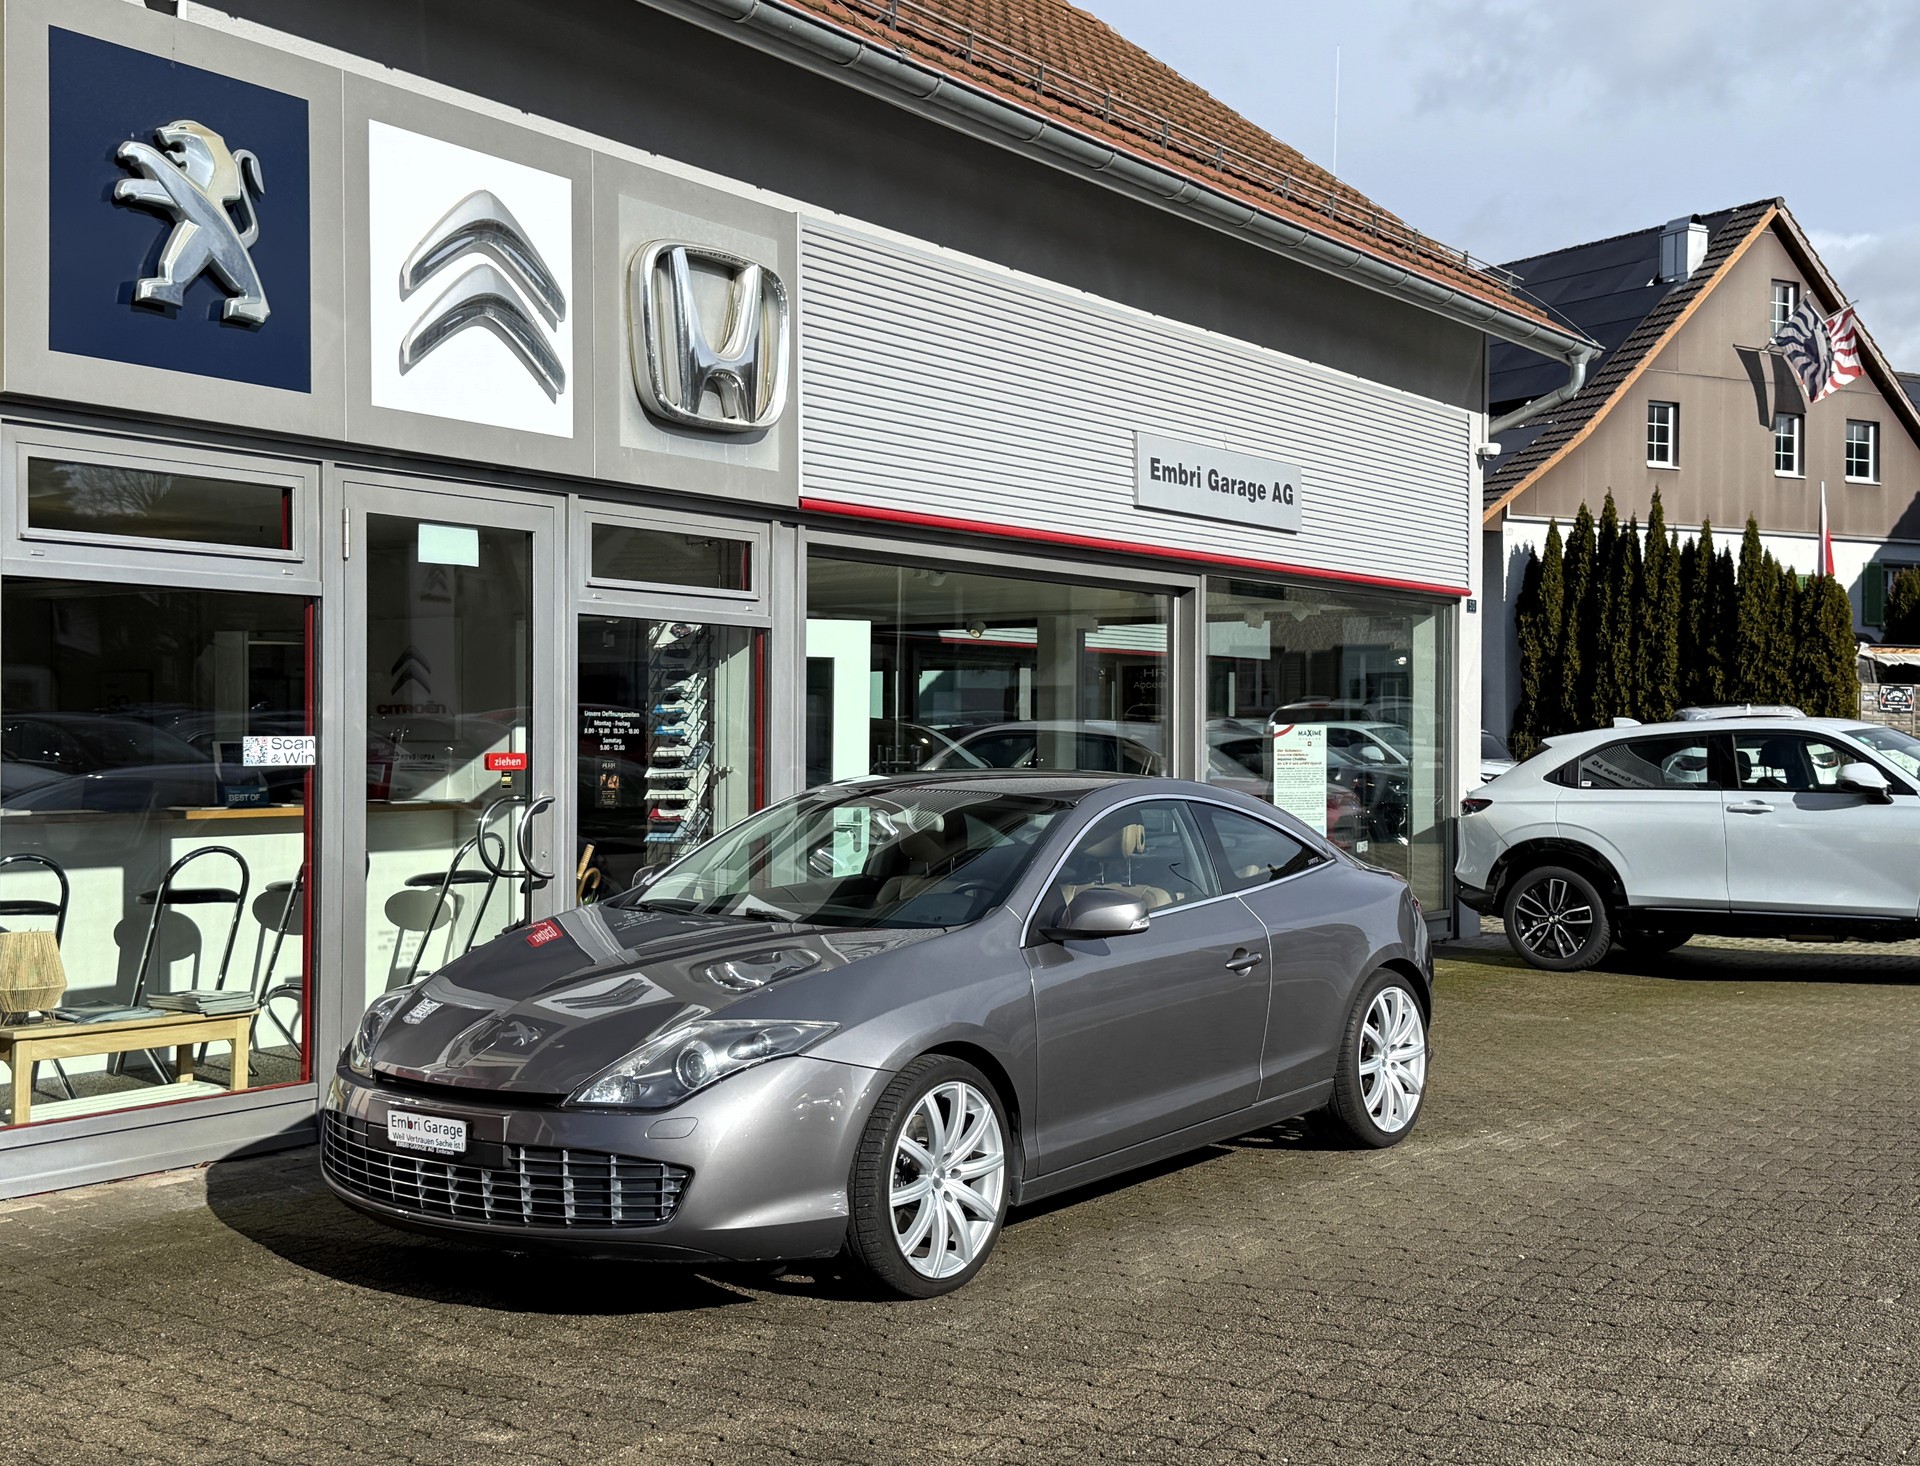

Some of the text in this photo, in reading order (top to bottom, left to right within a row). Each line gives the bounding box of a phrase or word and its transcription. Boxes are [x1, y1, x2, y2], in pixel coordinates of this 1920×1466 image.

[1150, 456, 1294, 506] Embri Garage AG
[271, 737, 315, 750] Scan
[270, 750, 315, 764] & Win
[494, 756, 522, 767] ziehen
[228, 794, 249, 802] BEST
[391, 1114, 463, 1140] Embri Garage
[406, 1133, 435, 1145] Vertrauen
[435, 1138, 453, 1149] Sache
